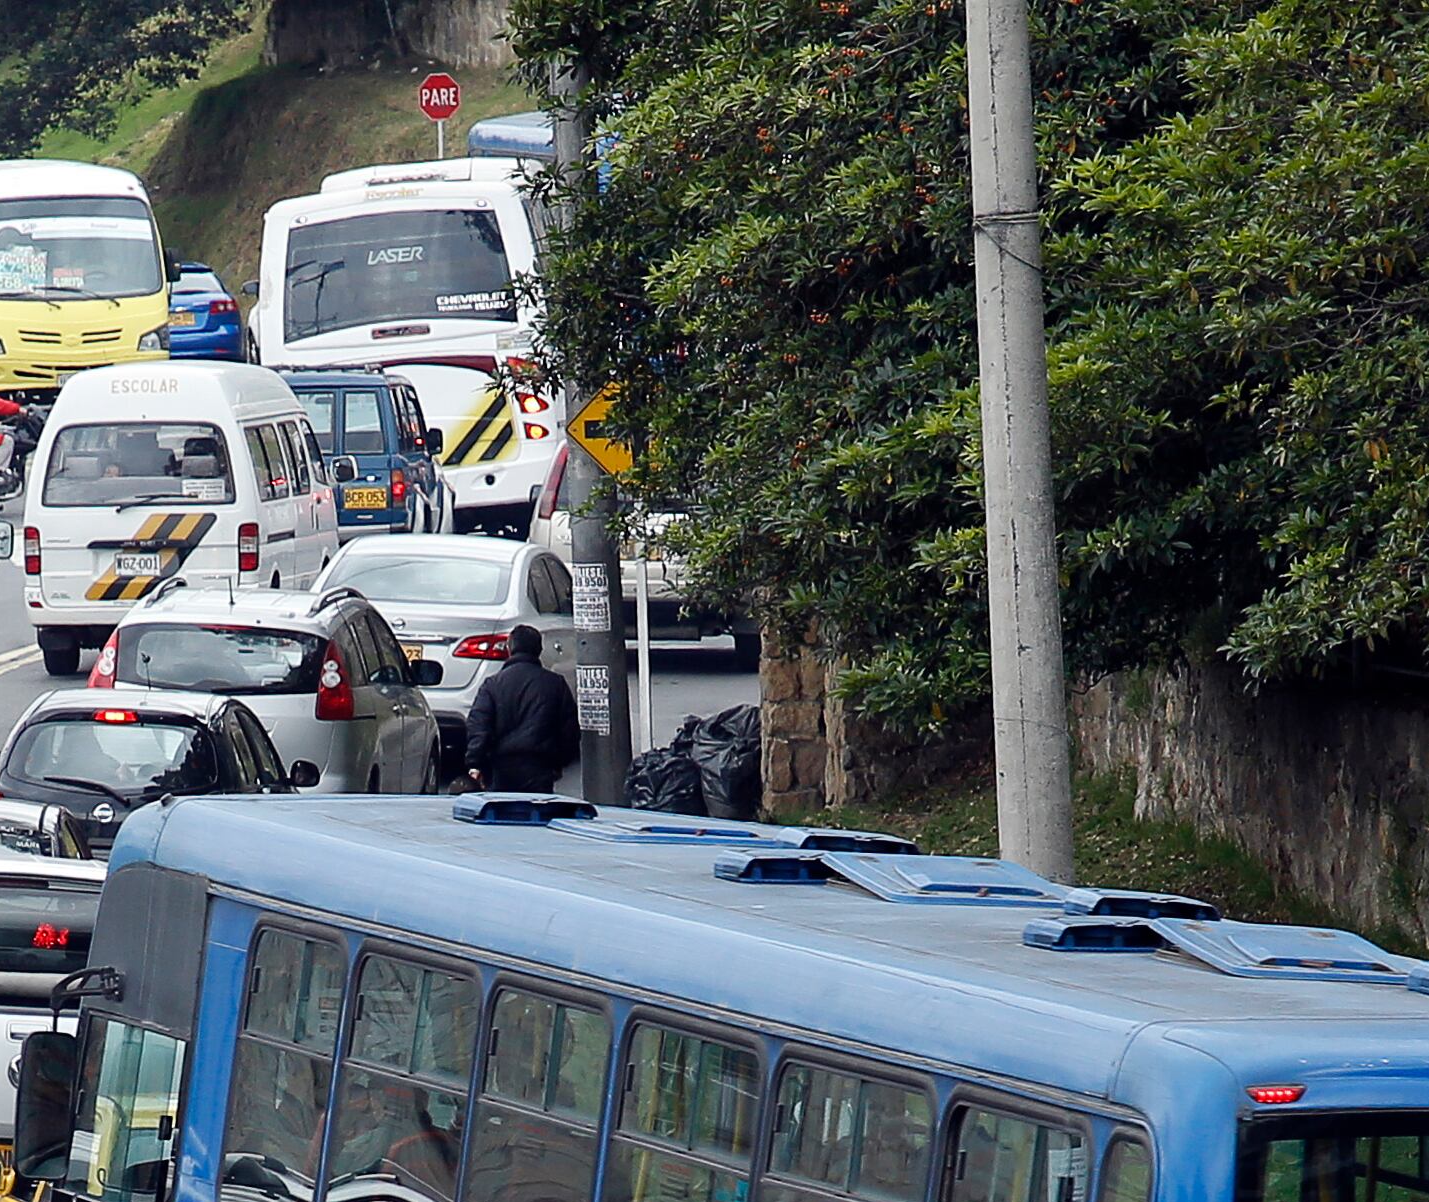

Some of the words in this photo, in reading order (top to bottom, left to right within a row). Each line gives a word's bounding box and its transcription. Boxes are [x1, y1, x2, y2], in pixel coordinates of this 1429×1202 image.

[422, 88, 457, 107] PARE
[367, 246, 423, 265] LASER
[436, 292, 507, 305] CHEVROLET
[475, 301, 508, 311] ISUZU
[111, 379, 178, 394] ESCOLAR
